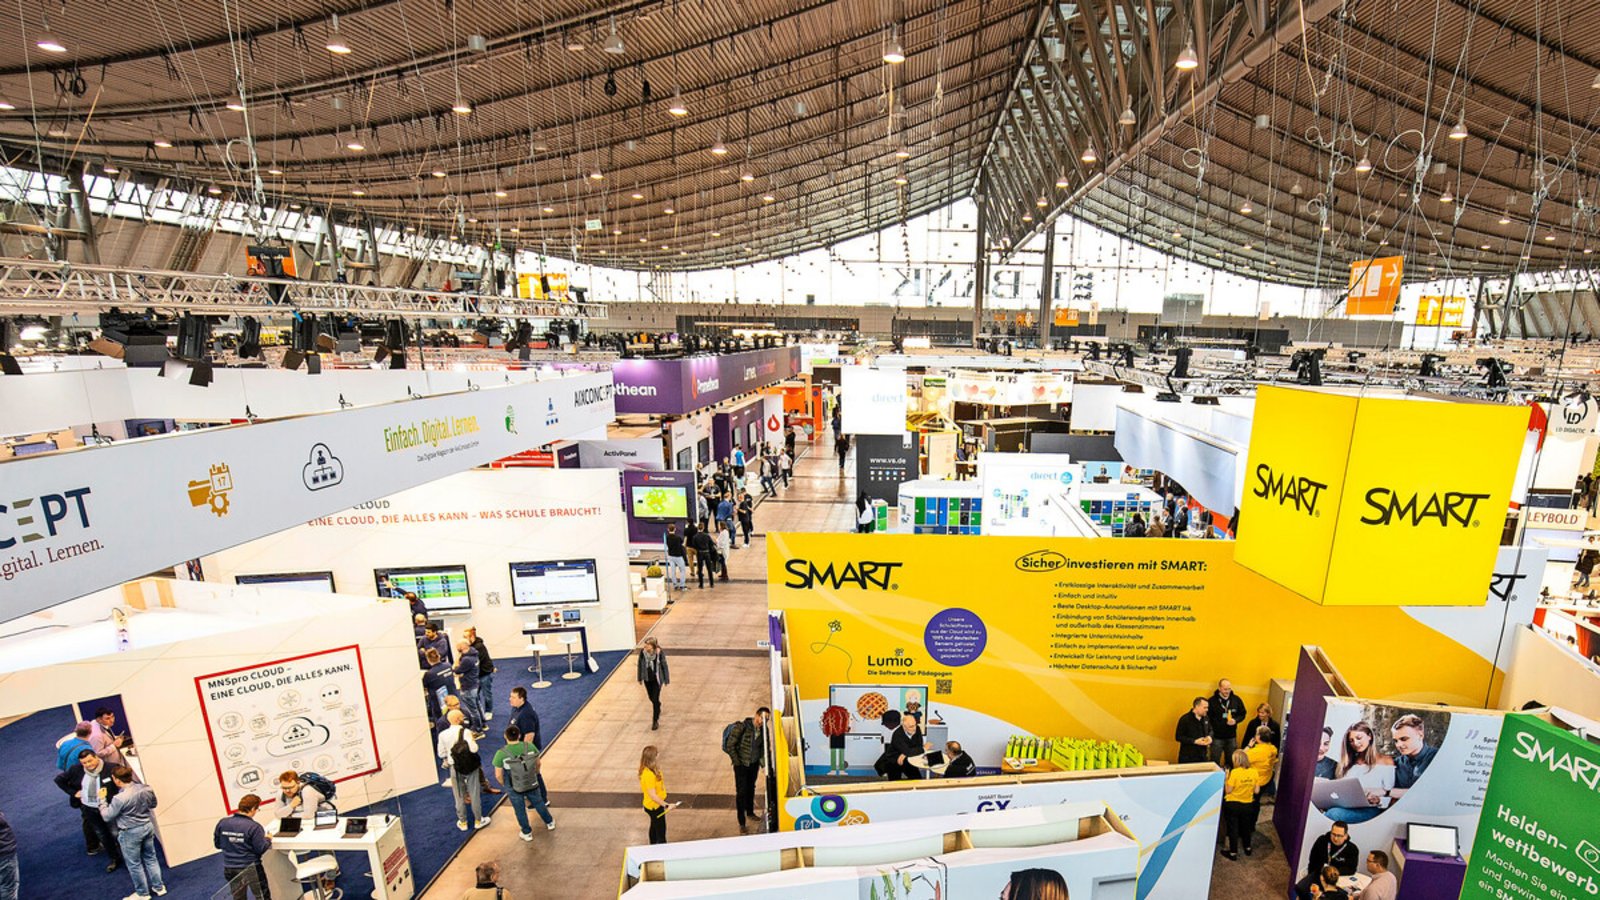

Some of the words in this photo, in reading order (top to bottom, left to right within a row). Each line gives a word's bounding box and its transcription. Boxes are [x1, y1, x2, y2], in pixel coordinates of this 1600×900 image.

[384, 424, 422, 452] Einfach.
[422, 416, 452, 448] Digital.
[451, 415, 480, 437] Lernen.
[1030, 470, 1058, 480] direct
[1253, 463, 1328, 516] SMART
[308, 516, 334, 527] EINE
[336, 515, 380, 526] CLOUD,
[382, 514, 400, 524] DIE
[402, 512, 436, 522] ALLES
[438, 511, 468, 521] KANN
[480, 510, 503, 520] WAS
[504, 508, 547, 518] SCHULE
[550, 507, 602, 518] BRAUCHT!
[1360, 487, 1491, 528] SMART
[1527, 511, 1578, 525] LEYBOLD
[46, 539, 104, 564] Lernen.
[785, 558, 903, 591] SMART
[1022, 557, 1062, 569] Sicher
[1066, 558, 1134, 570] investieren
[1138, 560, 1158, 571] mit
[1160, 560, 1208, 572] SMART:
[868, 655, 914, 668] Lumio
[918, 670, 952, 678] Pädagogen
[208, 675, 249, 690] MNSpro
[250, 666, 285, 682] CLOUD
[210, 686, 235, 701] EINE
[236, 680, 276, 696] CLOUD,
[276, 676, 293, 688] DIE
[294, 670, 324, 683] ALLES
[325, 663, 353, 676] KANN.
[1512, 731, 1600, 791] SMART
[1497, 804, 1568, 850] Helden-
[1482, 866, 1503, 882] und
[1486, 850, 1530, 881] Machen
[1531, 875, 1548, 892] Sie
[1492, 828, 1598, 895] wettbewerb
[1478, 880, 1494, 894] ein
